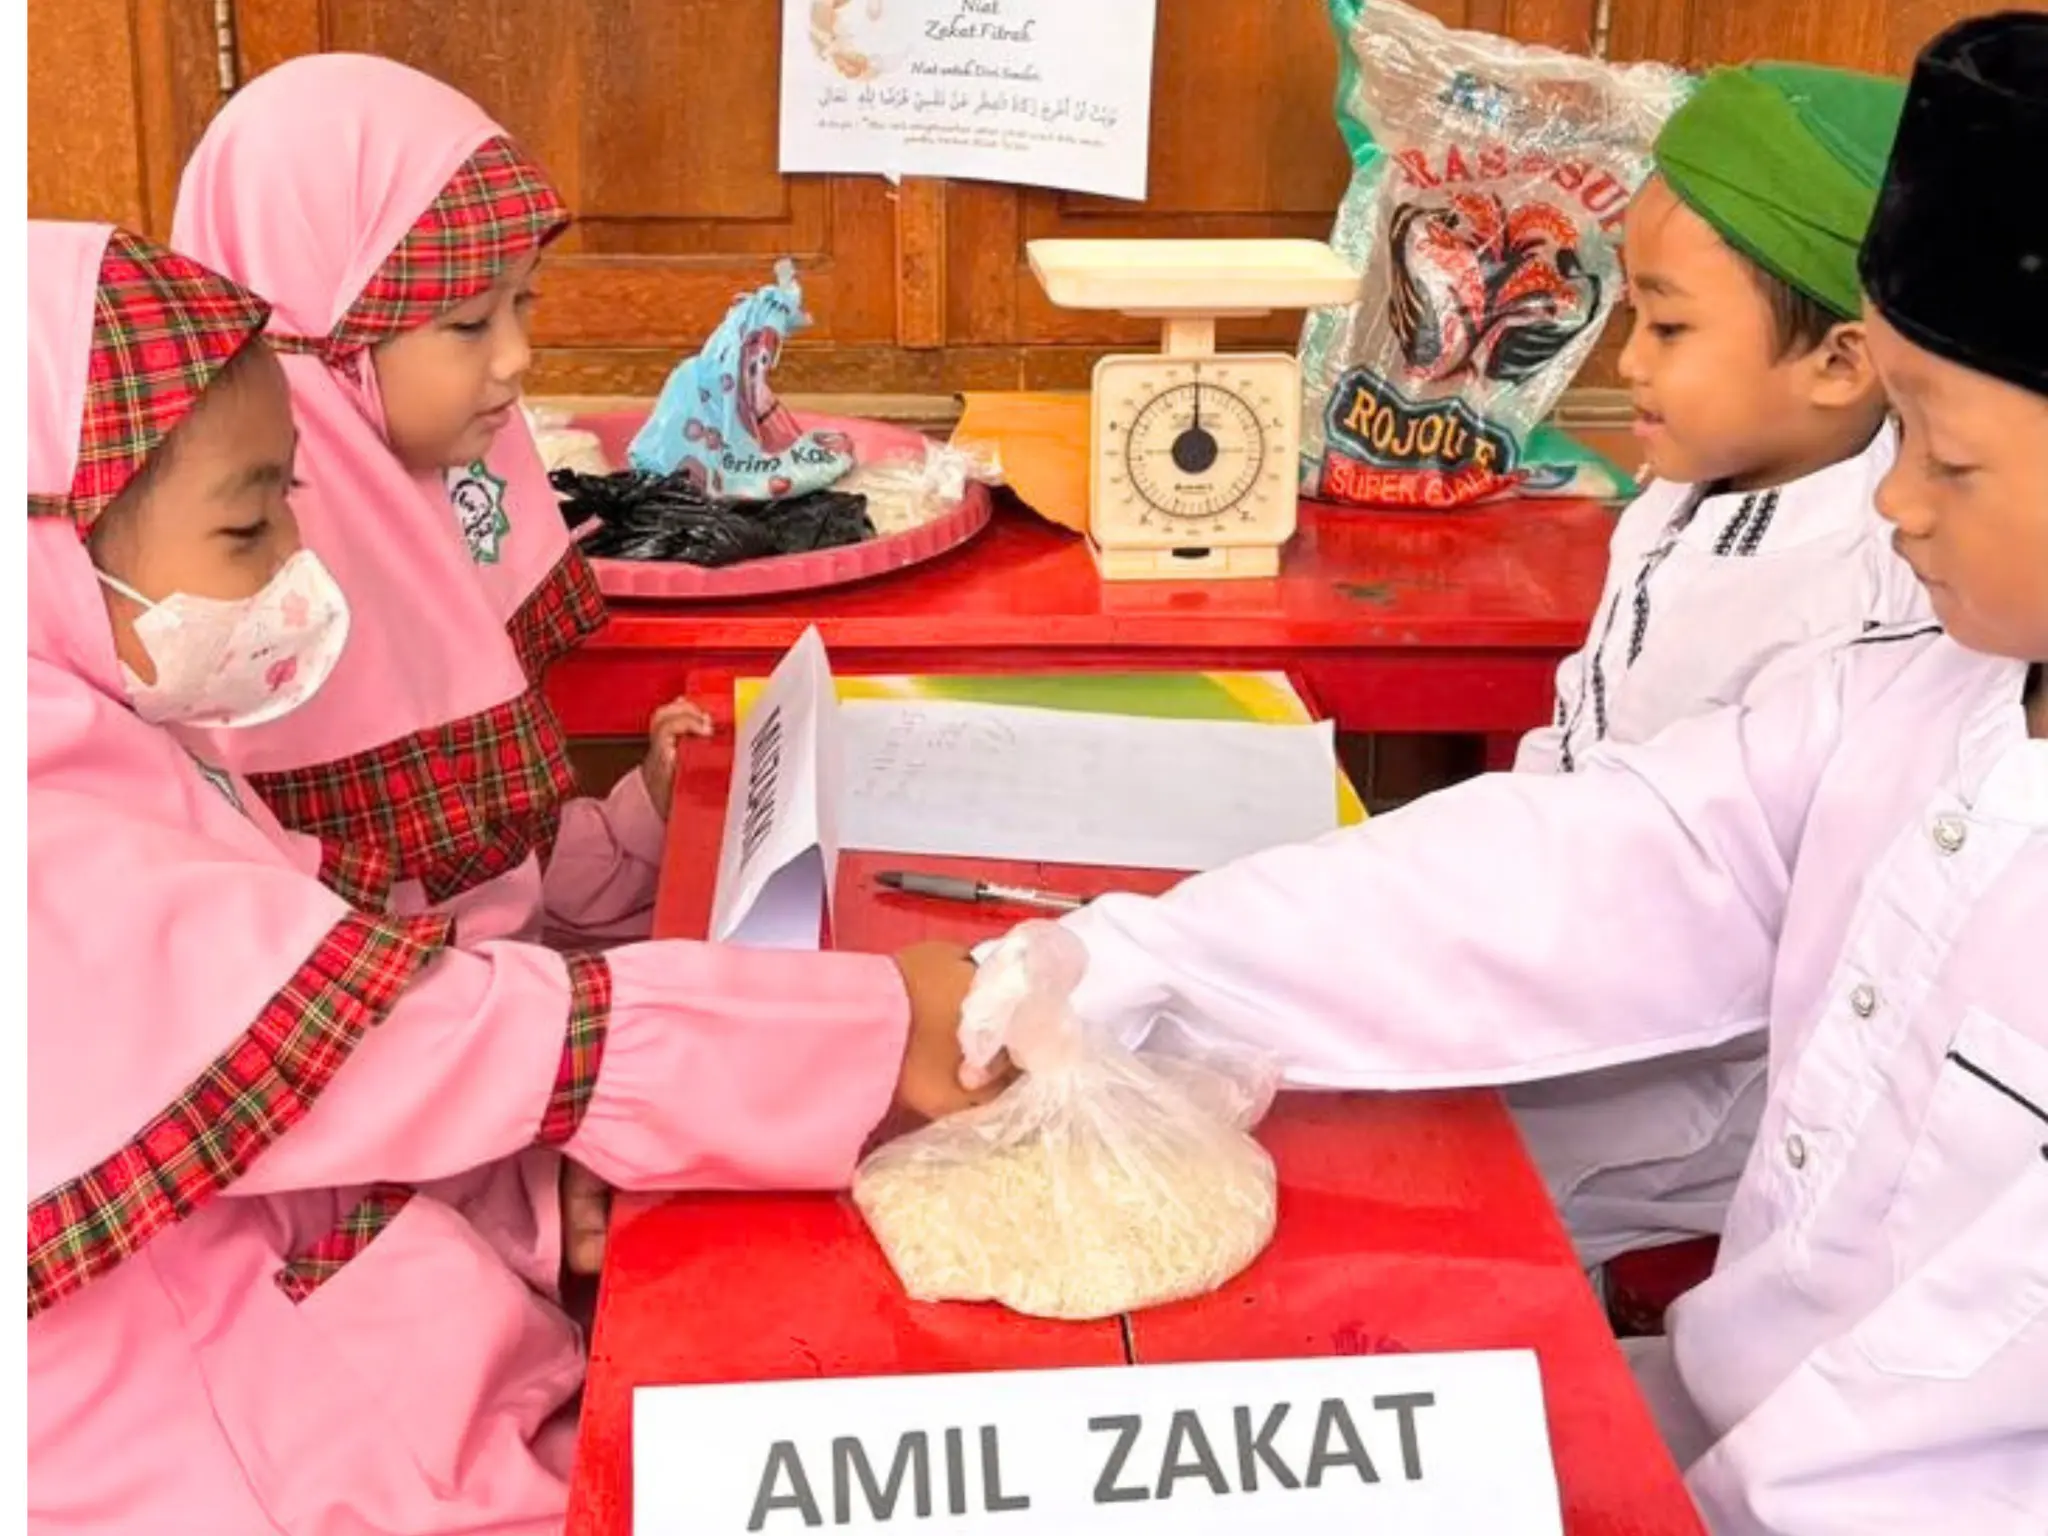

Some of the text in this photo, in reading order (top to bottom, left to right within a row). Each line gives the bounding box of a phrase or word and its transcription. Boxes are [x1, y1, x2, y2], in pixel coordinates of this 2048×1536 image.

[925, 14, 976, 41] Zakat
[746, 1391, 1436, 1532] AMIL ZAKAT
